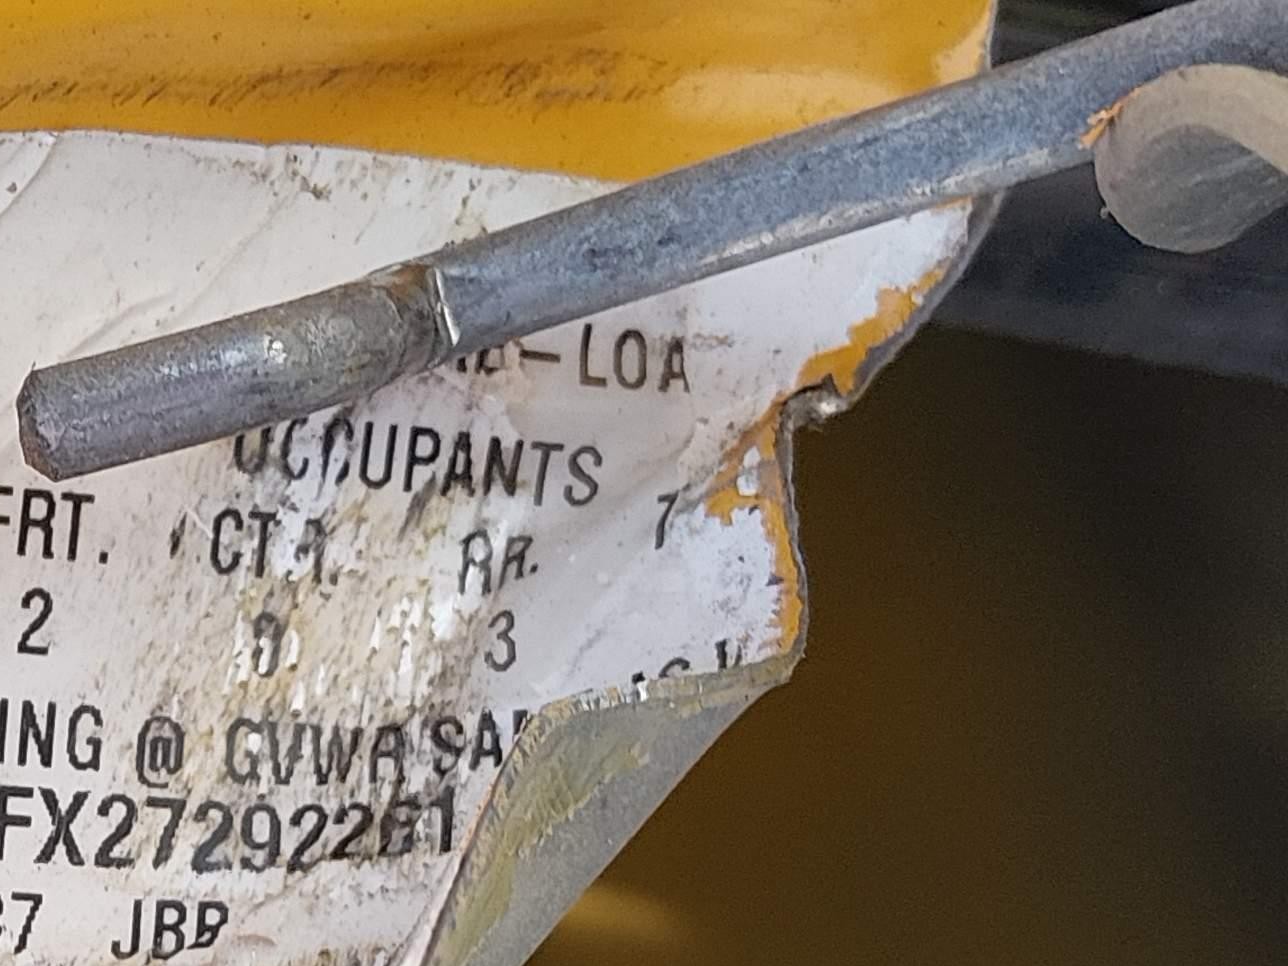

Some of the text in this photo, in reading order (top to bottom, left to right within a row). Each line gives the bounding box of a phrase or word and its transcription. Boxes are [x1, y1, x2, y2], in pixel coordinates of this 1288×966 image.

[17, 588, 53, 655] 2
[484, 610, 516, 672] 3
[136, 716, 185, 788] @
